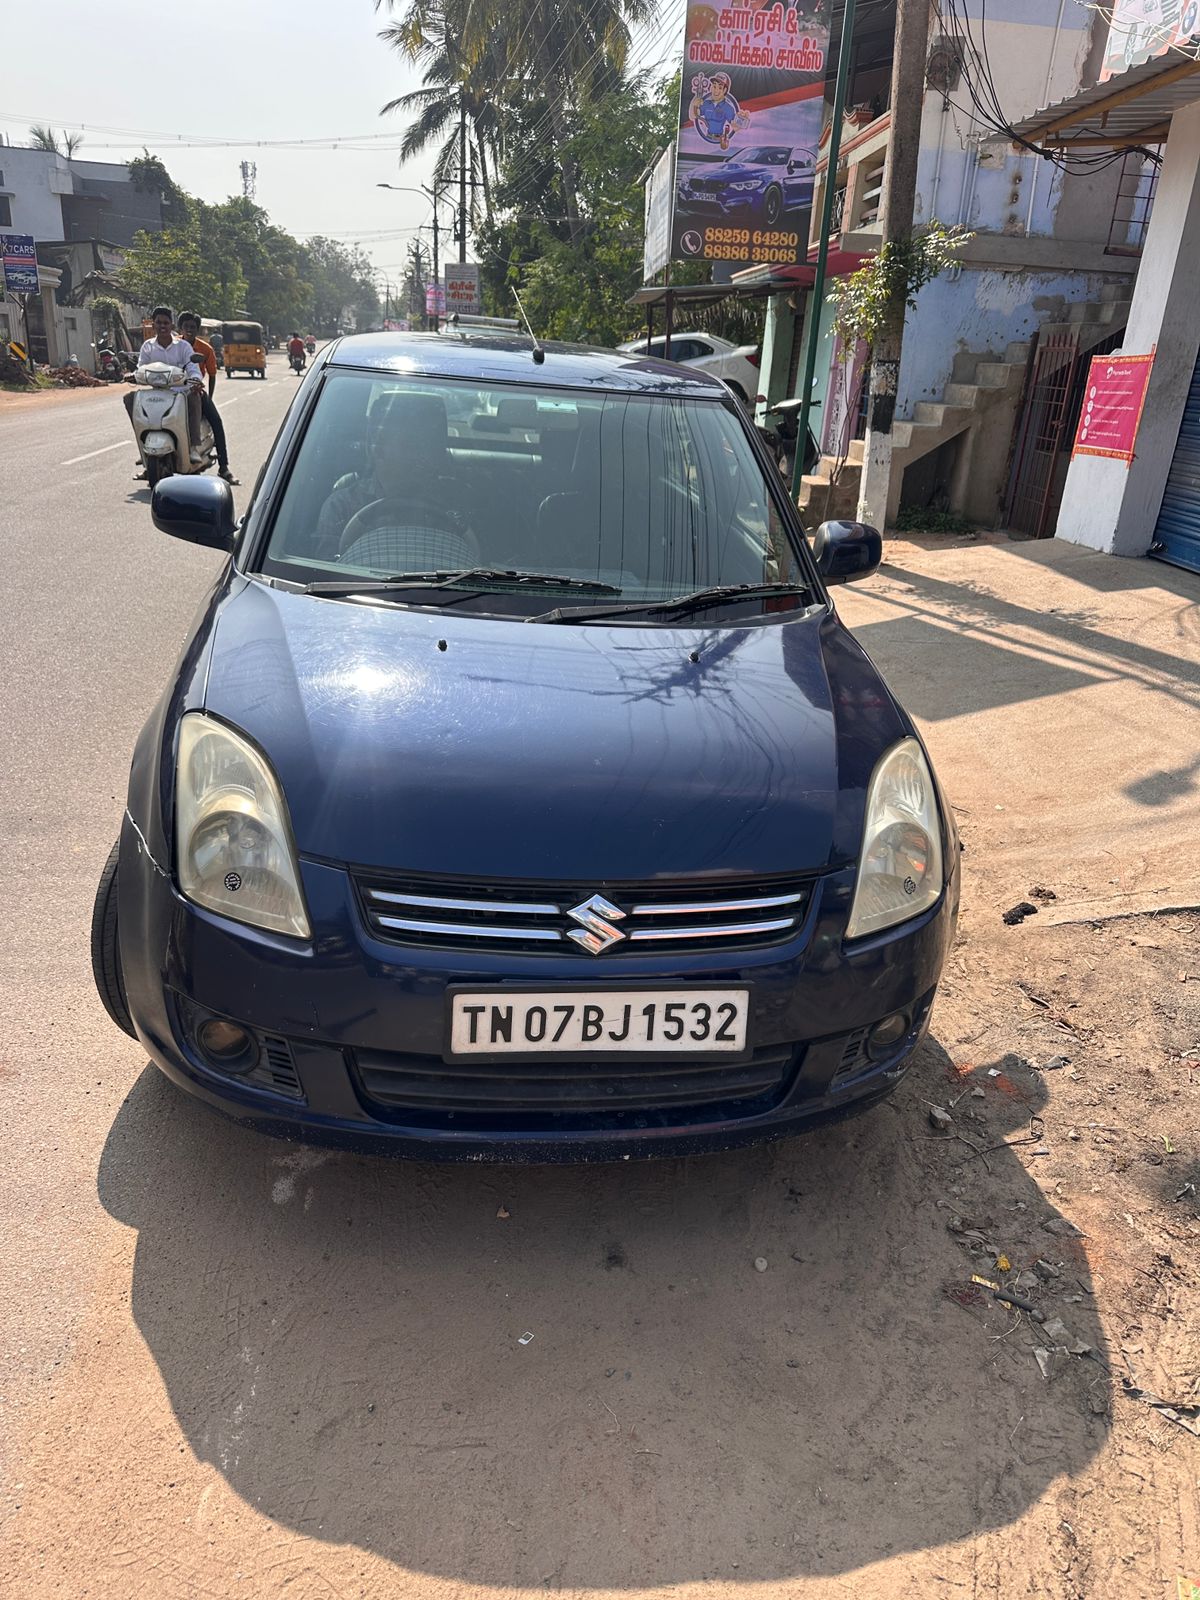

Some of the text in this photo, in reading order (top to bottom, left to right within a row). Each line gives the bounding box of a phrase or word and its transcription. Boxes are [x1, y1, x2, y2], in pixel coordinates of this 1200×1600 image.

[719, 0, 798, 38] கார் ஏசி &
[775, 36, 822, 71] சர்வீஸ்
[705, 227, 798, 247] 88259 64280
[703, 243, 797, 263] 88386 33068
